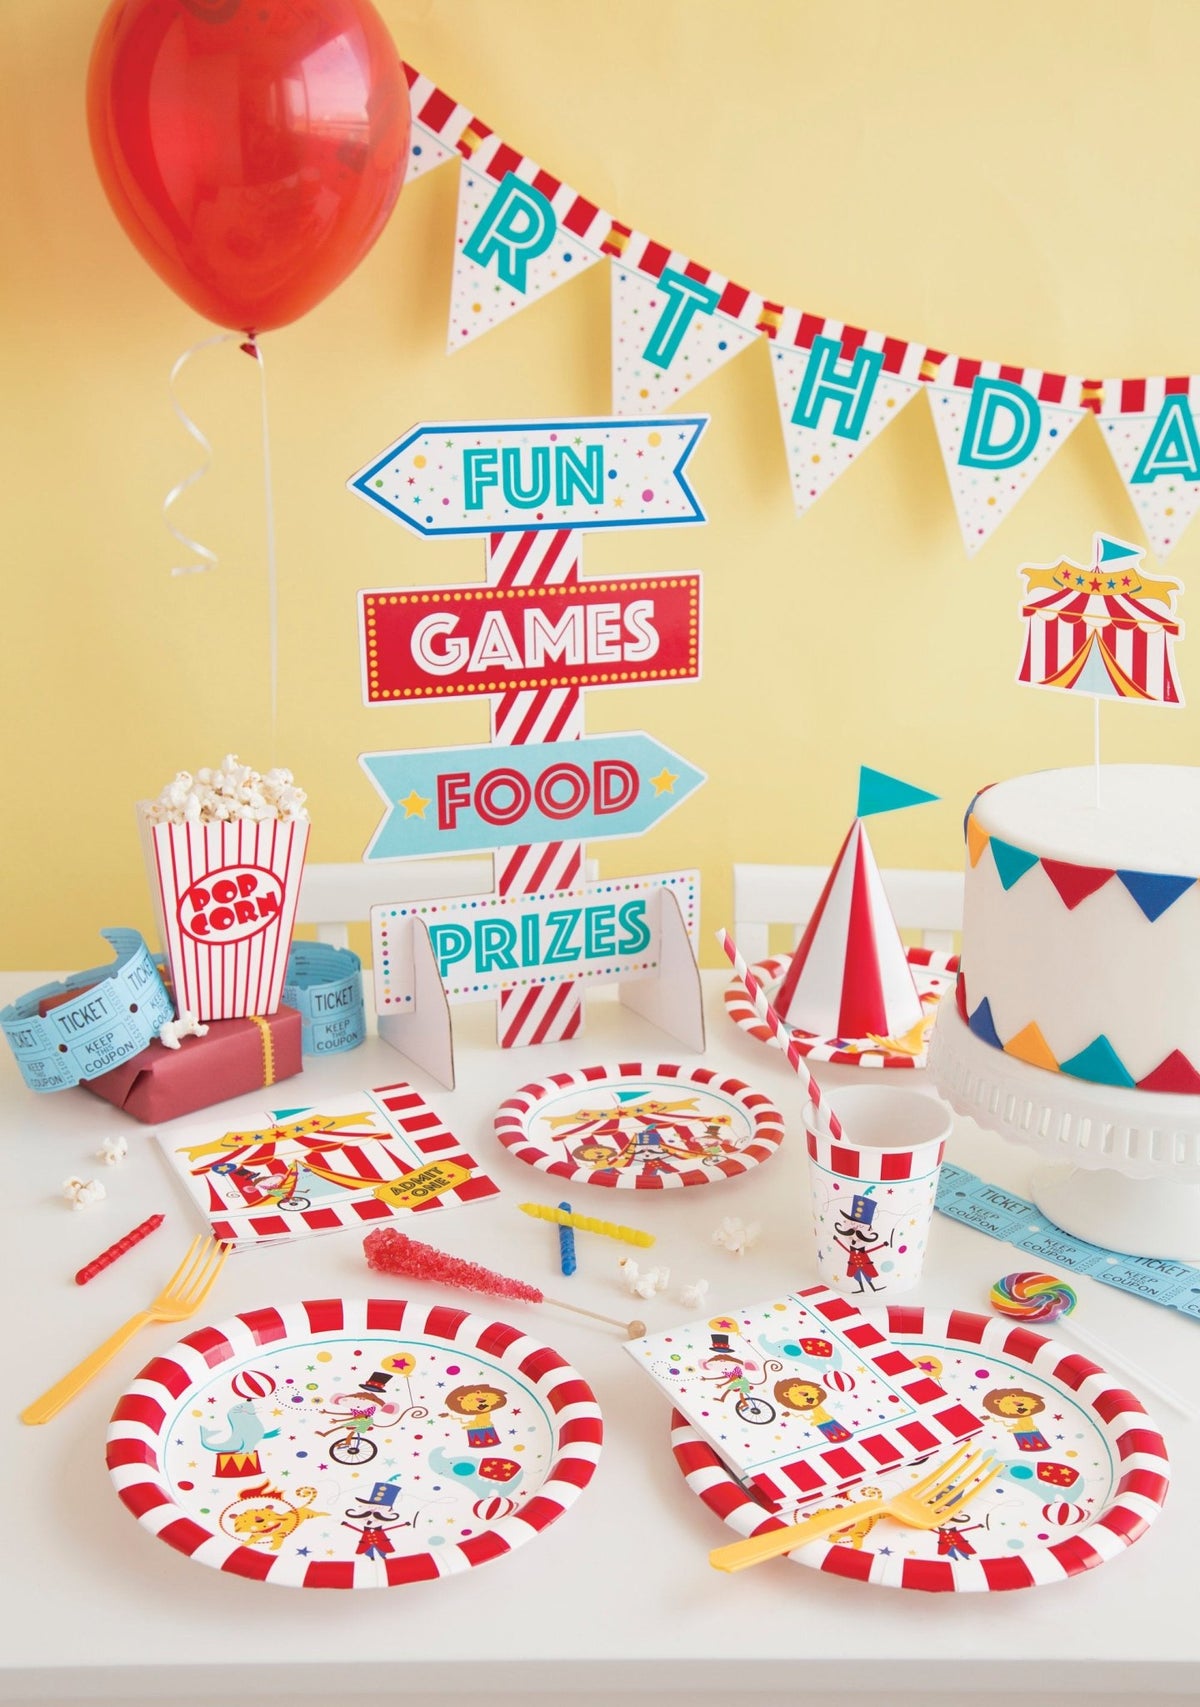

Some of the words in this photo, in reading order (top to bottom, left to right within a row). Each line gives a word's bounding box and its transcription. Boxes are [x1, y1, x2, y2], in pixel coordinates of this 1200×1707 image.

[463, 445, 604, 510] FUN
[410, 600, 660, 676] GAMES
[436, 760, 640, 831] FOOD
[189, 873, 258, 912] POP
[190, 891, 281, 935] CORN
[428, 900, 651, 977] PRIZES
[315, 986, 353, 1012] TICKET
[58, 997, 107, 1034] TICKET
[325, 1019, 350, 1034] KEEP
[85, 1032, 114, 1053] KEEP
[316, 1032, 358, 1051] COUPON
[85, 1041, 134, 1073] COUPON
[390, 1166, 444, 1196] ADMIT
[411, 1177, 450, 1197] ONE
[980, 1189, 1031, 1215] TICKET
[949, 1207, 998, 1231] COUPON
[1023, 1241, 1076, 1265] COUPON
[1124, 1270, 1159, 1283] KEEP
[1134, 1257, 1190, 1277] TICKET
[1102, 1273, 1160, 1295] COUPON
